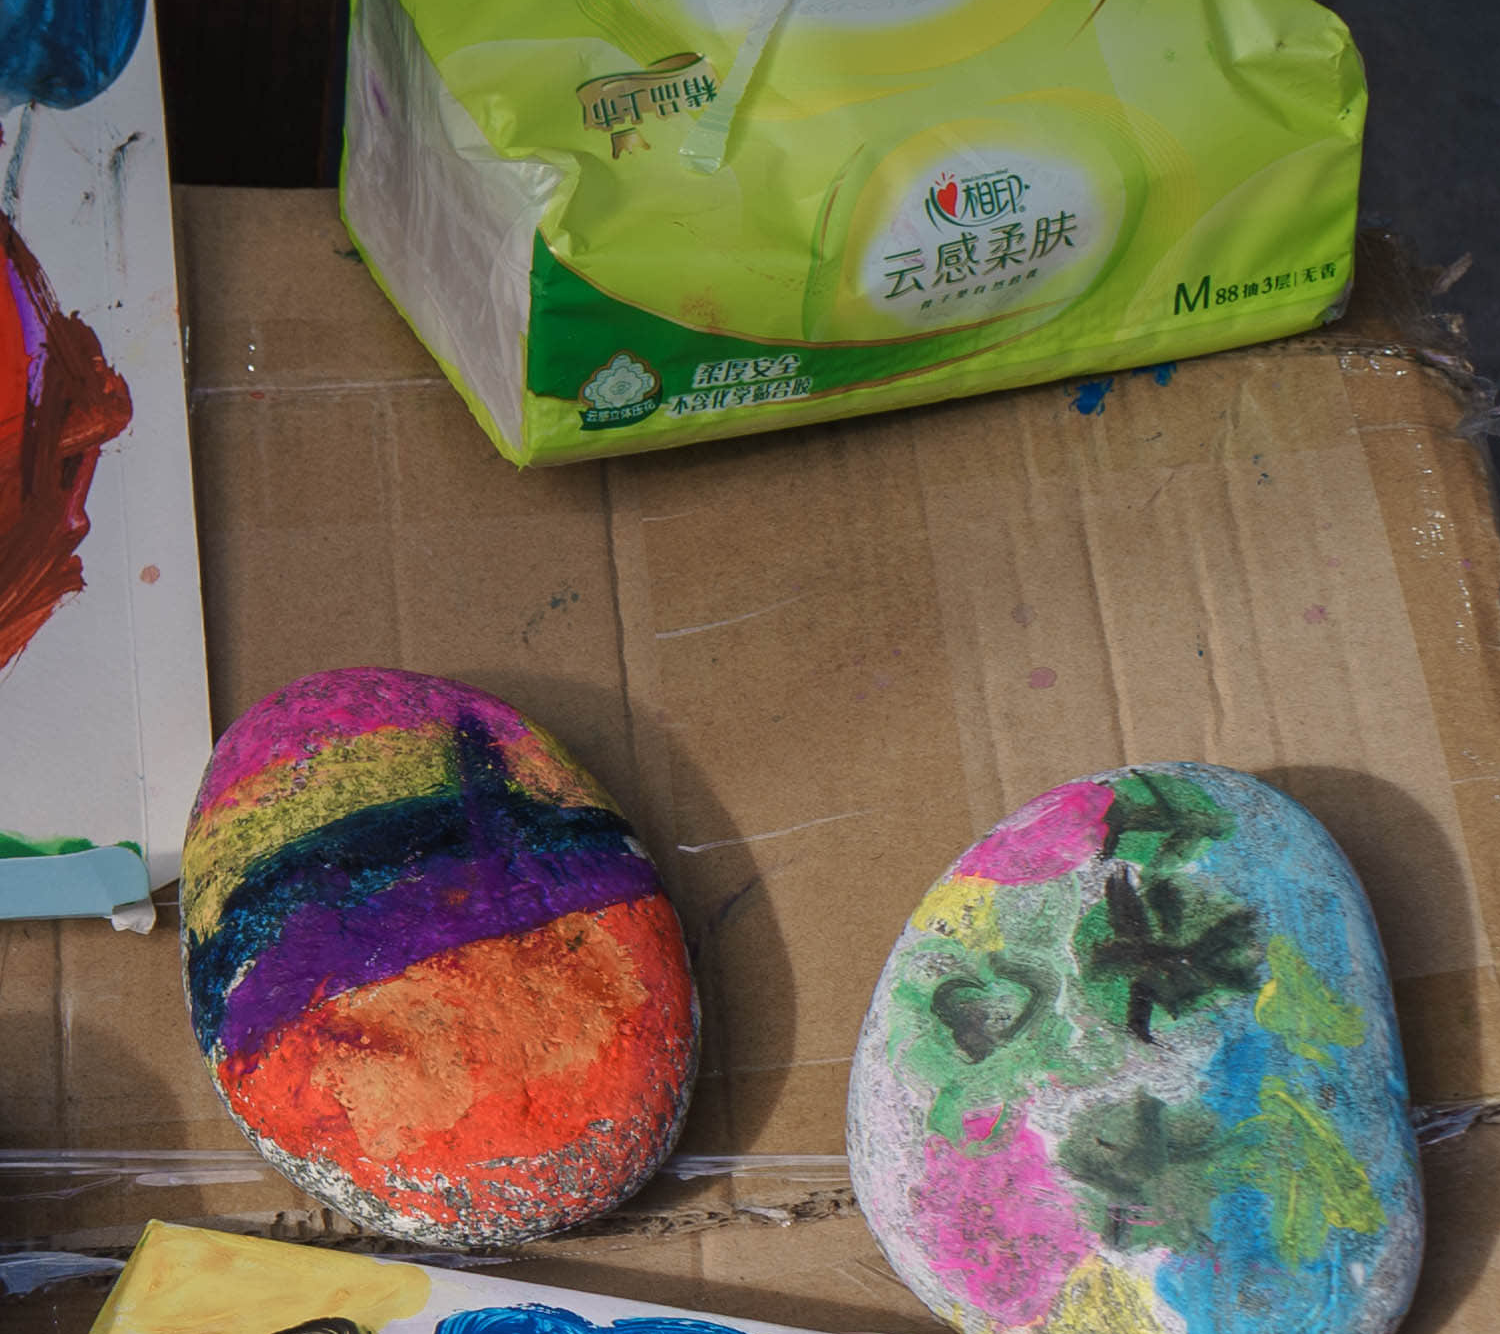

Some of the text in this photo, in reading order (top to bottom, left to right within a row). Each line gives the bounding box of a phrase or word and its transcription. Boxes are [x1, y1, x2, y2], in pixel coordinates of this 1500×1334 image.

[593, 75, 718, 127] 精品上市
[883, 211, 1078, 301] 云感柔肤
[1173, 274, 1212, 315] M
